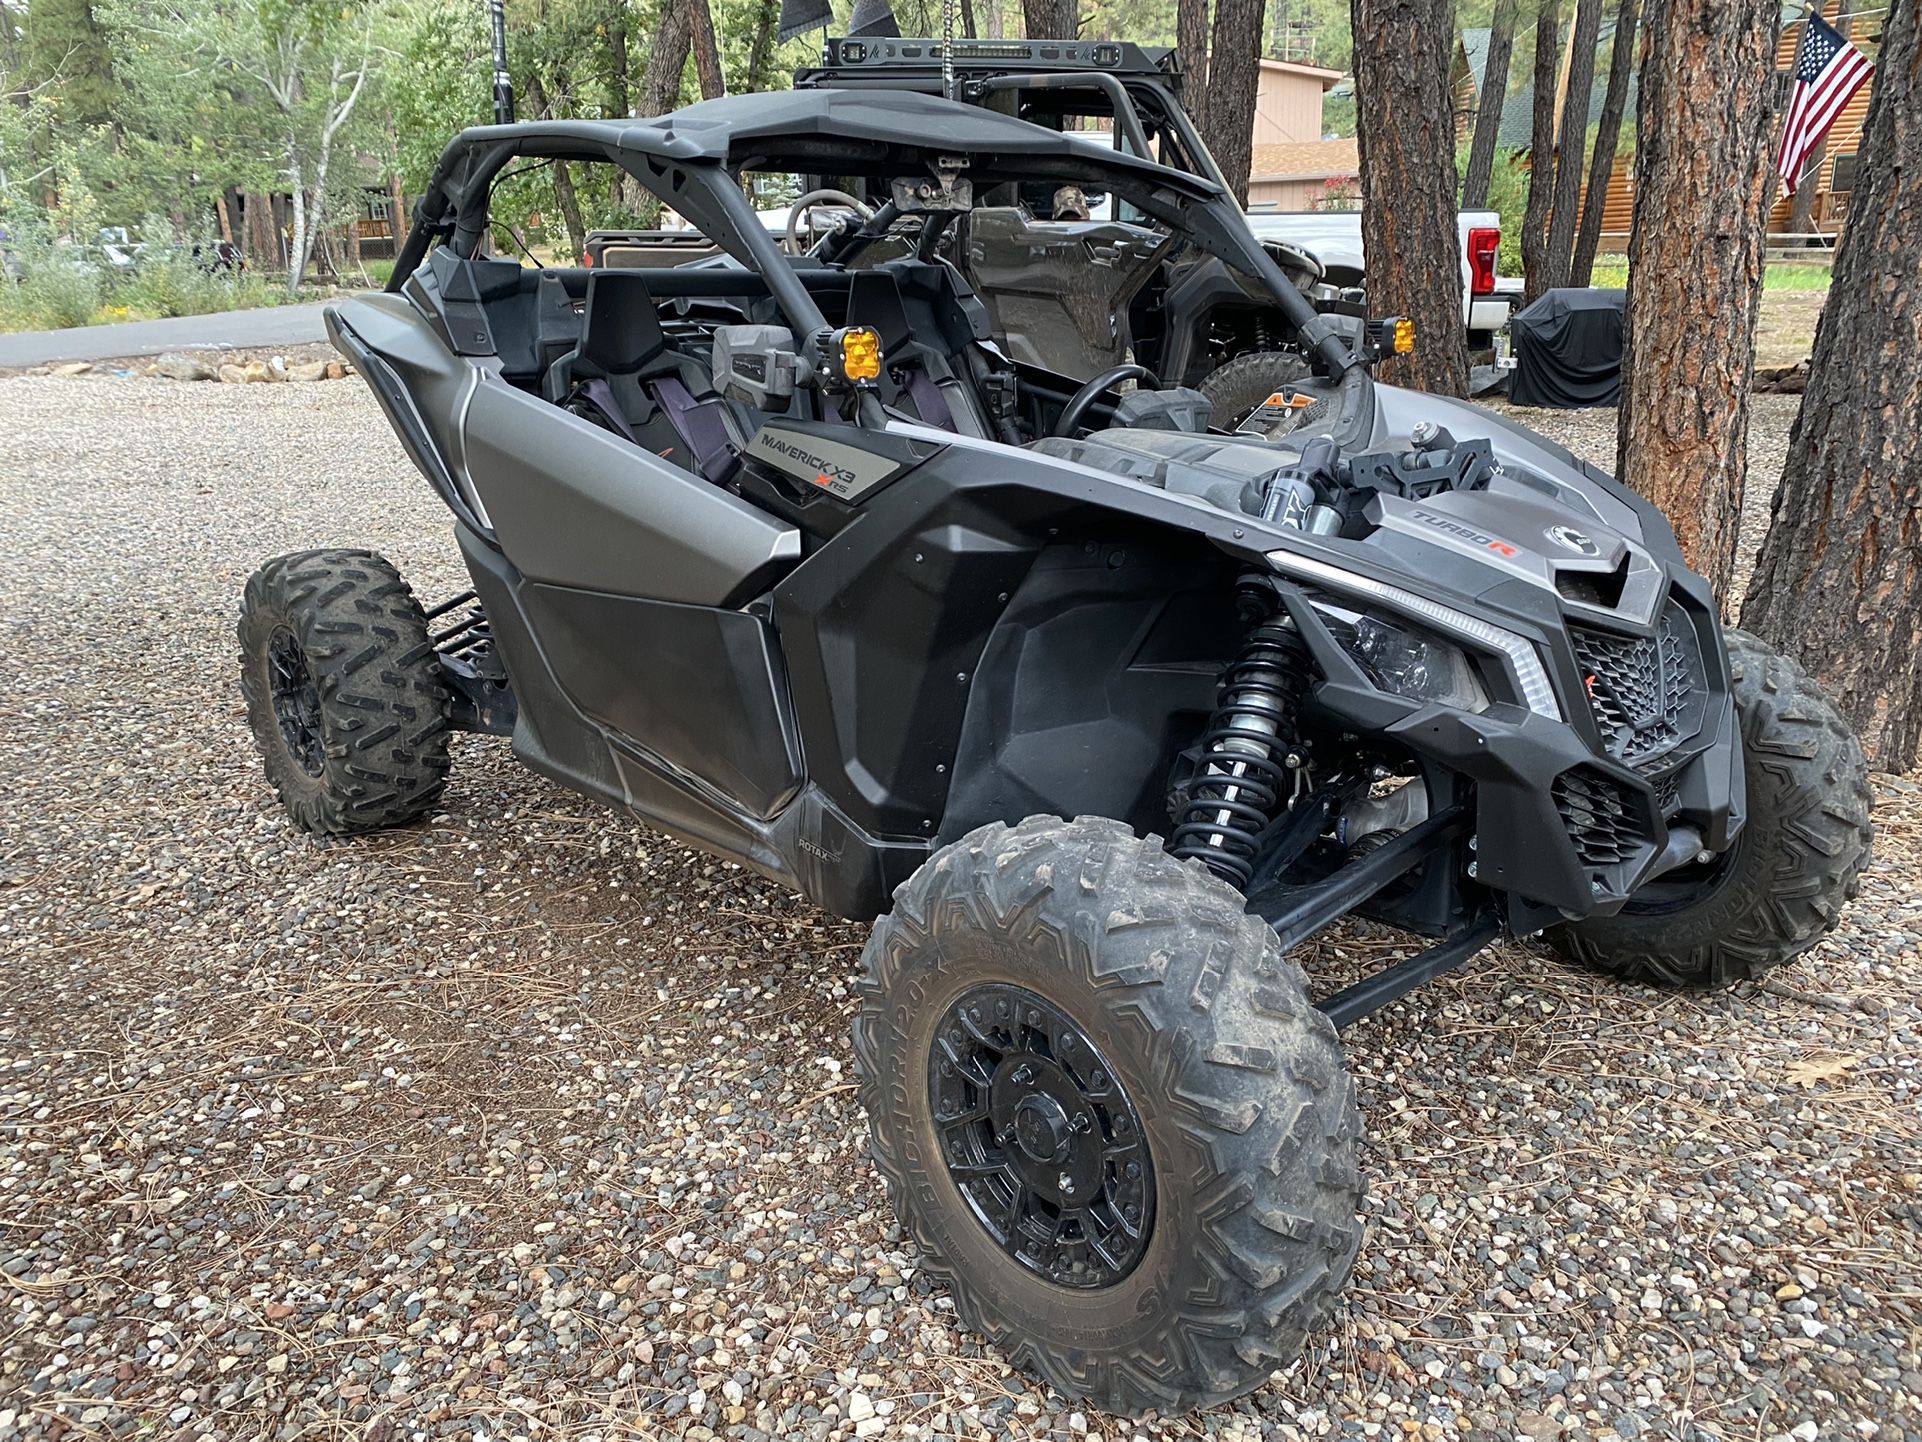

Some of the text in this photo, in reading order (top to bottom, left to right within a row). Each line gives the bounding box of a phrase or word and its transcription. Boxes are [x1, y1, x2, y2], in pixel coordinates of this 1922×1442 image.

[761, 433, 856, 484] MAVERICK X3
[1412, 511, 1490, 546] TURBO
[799, 838, 828, 861] ROTAX
